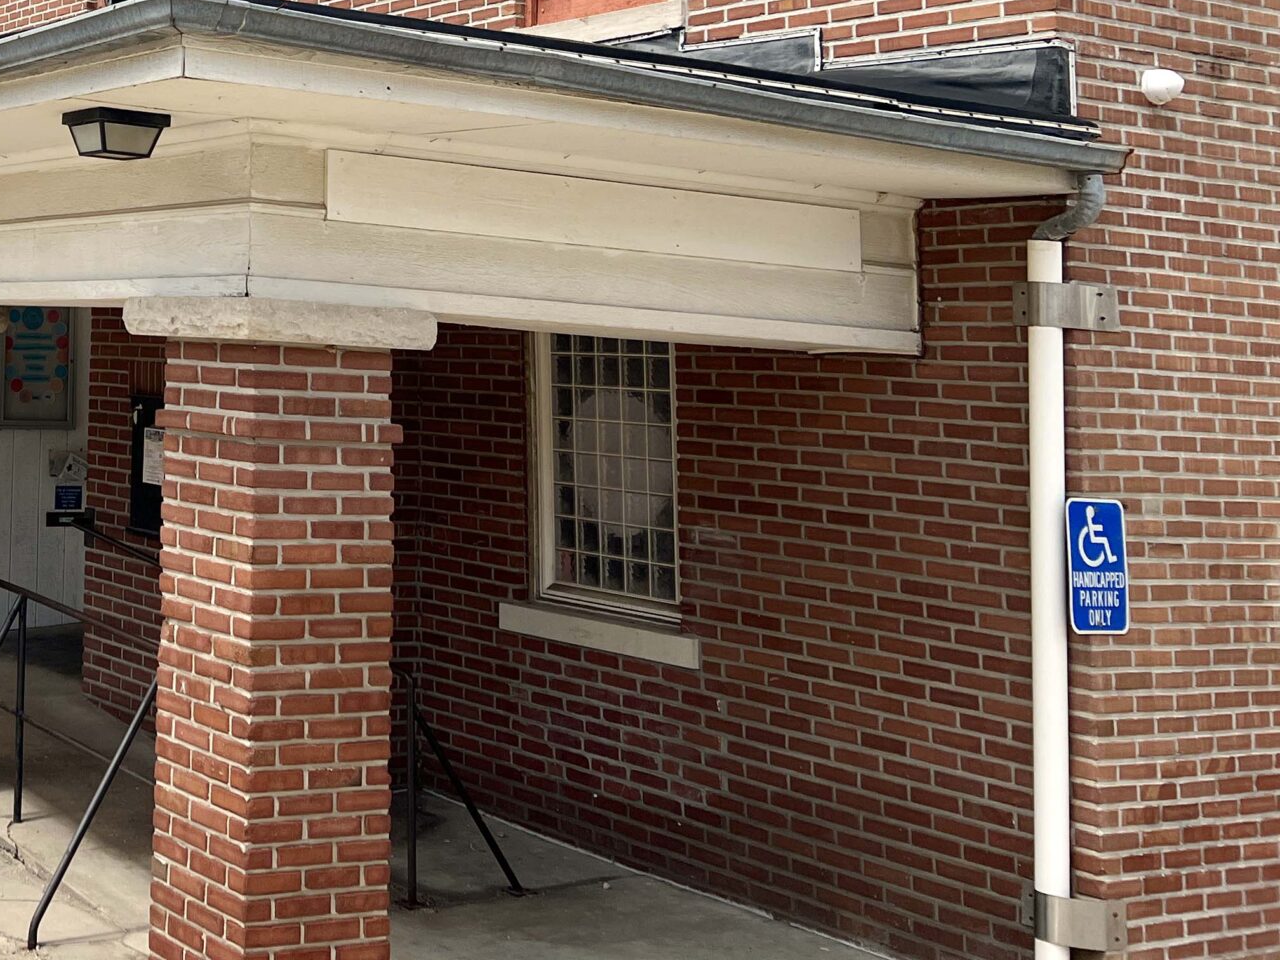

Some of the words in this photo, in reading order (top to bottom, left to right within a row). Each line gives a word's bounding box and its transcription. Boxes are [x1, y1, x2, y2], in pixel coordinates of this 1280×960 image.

[1073, 571, 1125, 588] HANDICAPPED
[1080, 590, 1120, 607] PARKING
[1089, 609, 1111, 626] ONLY
